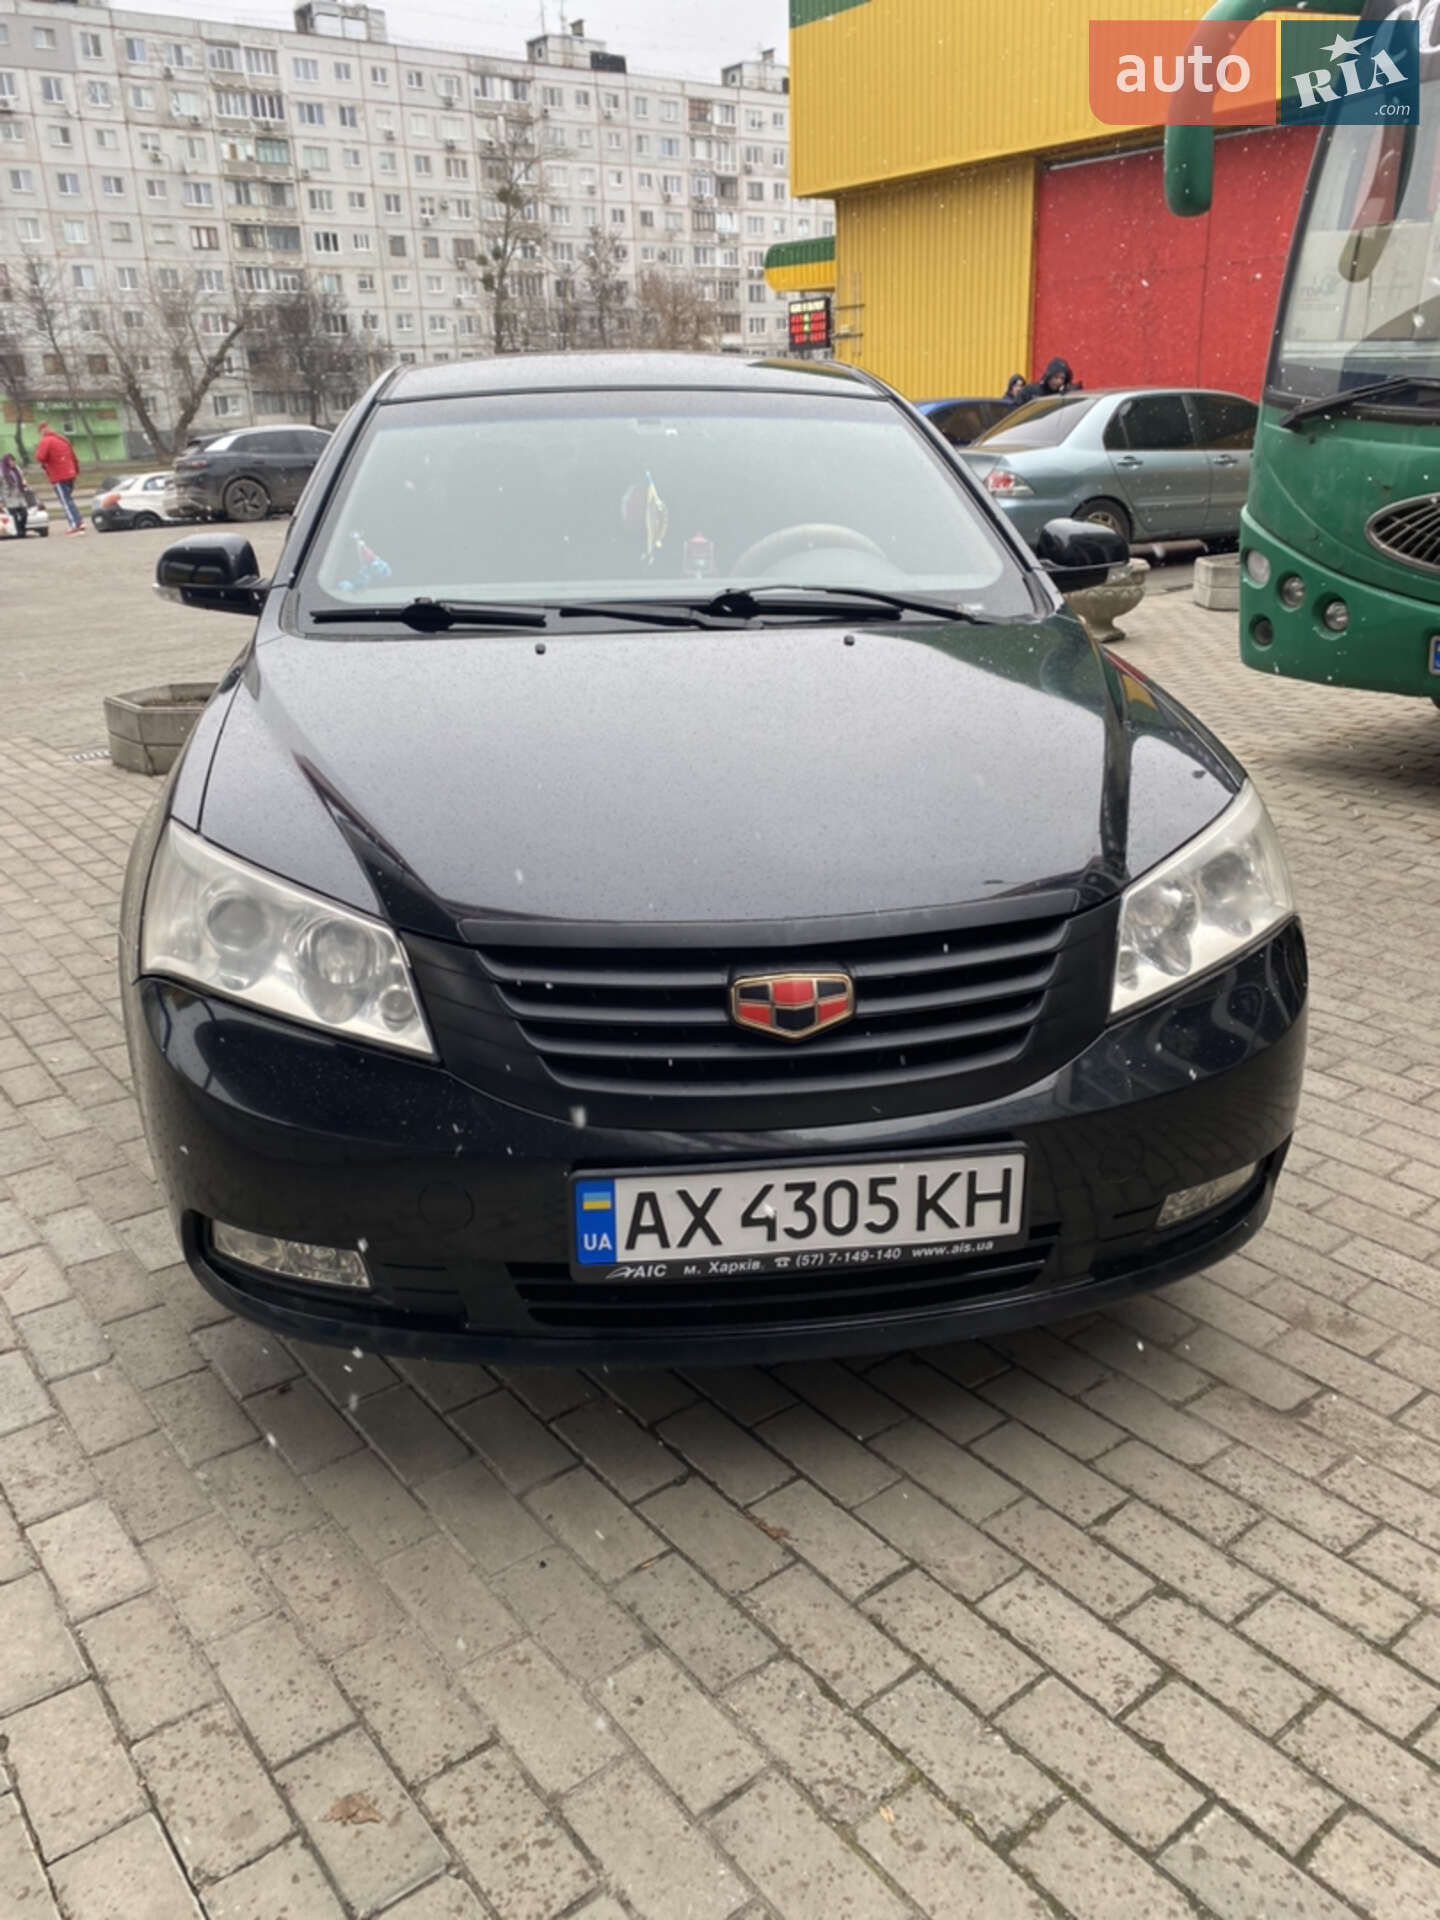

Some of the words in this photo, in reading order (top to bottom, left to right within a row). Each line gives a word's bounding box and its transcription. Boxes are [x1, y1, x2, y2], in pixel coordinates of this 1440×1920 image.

[625, 1187, 722, 1250] AX
[740, 1176, 898, 1242] 4305
[916, 1167, 1011, 1232] KH
[583, 1234, 612, 1250] UA
[795, 1253, 824, 1267] (57)
[828, 1248, 901, 1264] 7-149-140
[912, 1241, 994, 1258] www.ais.ua
